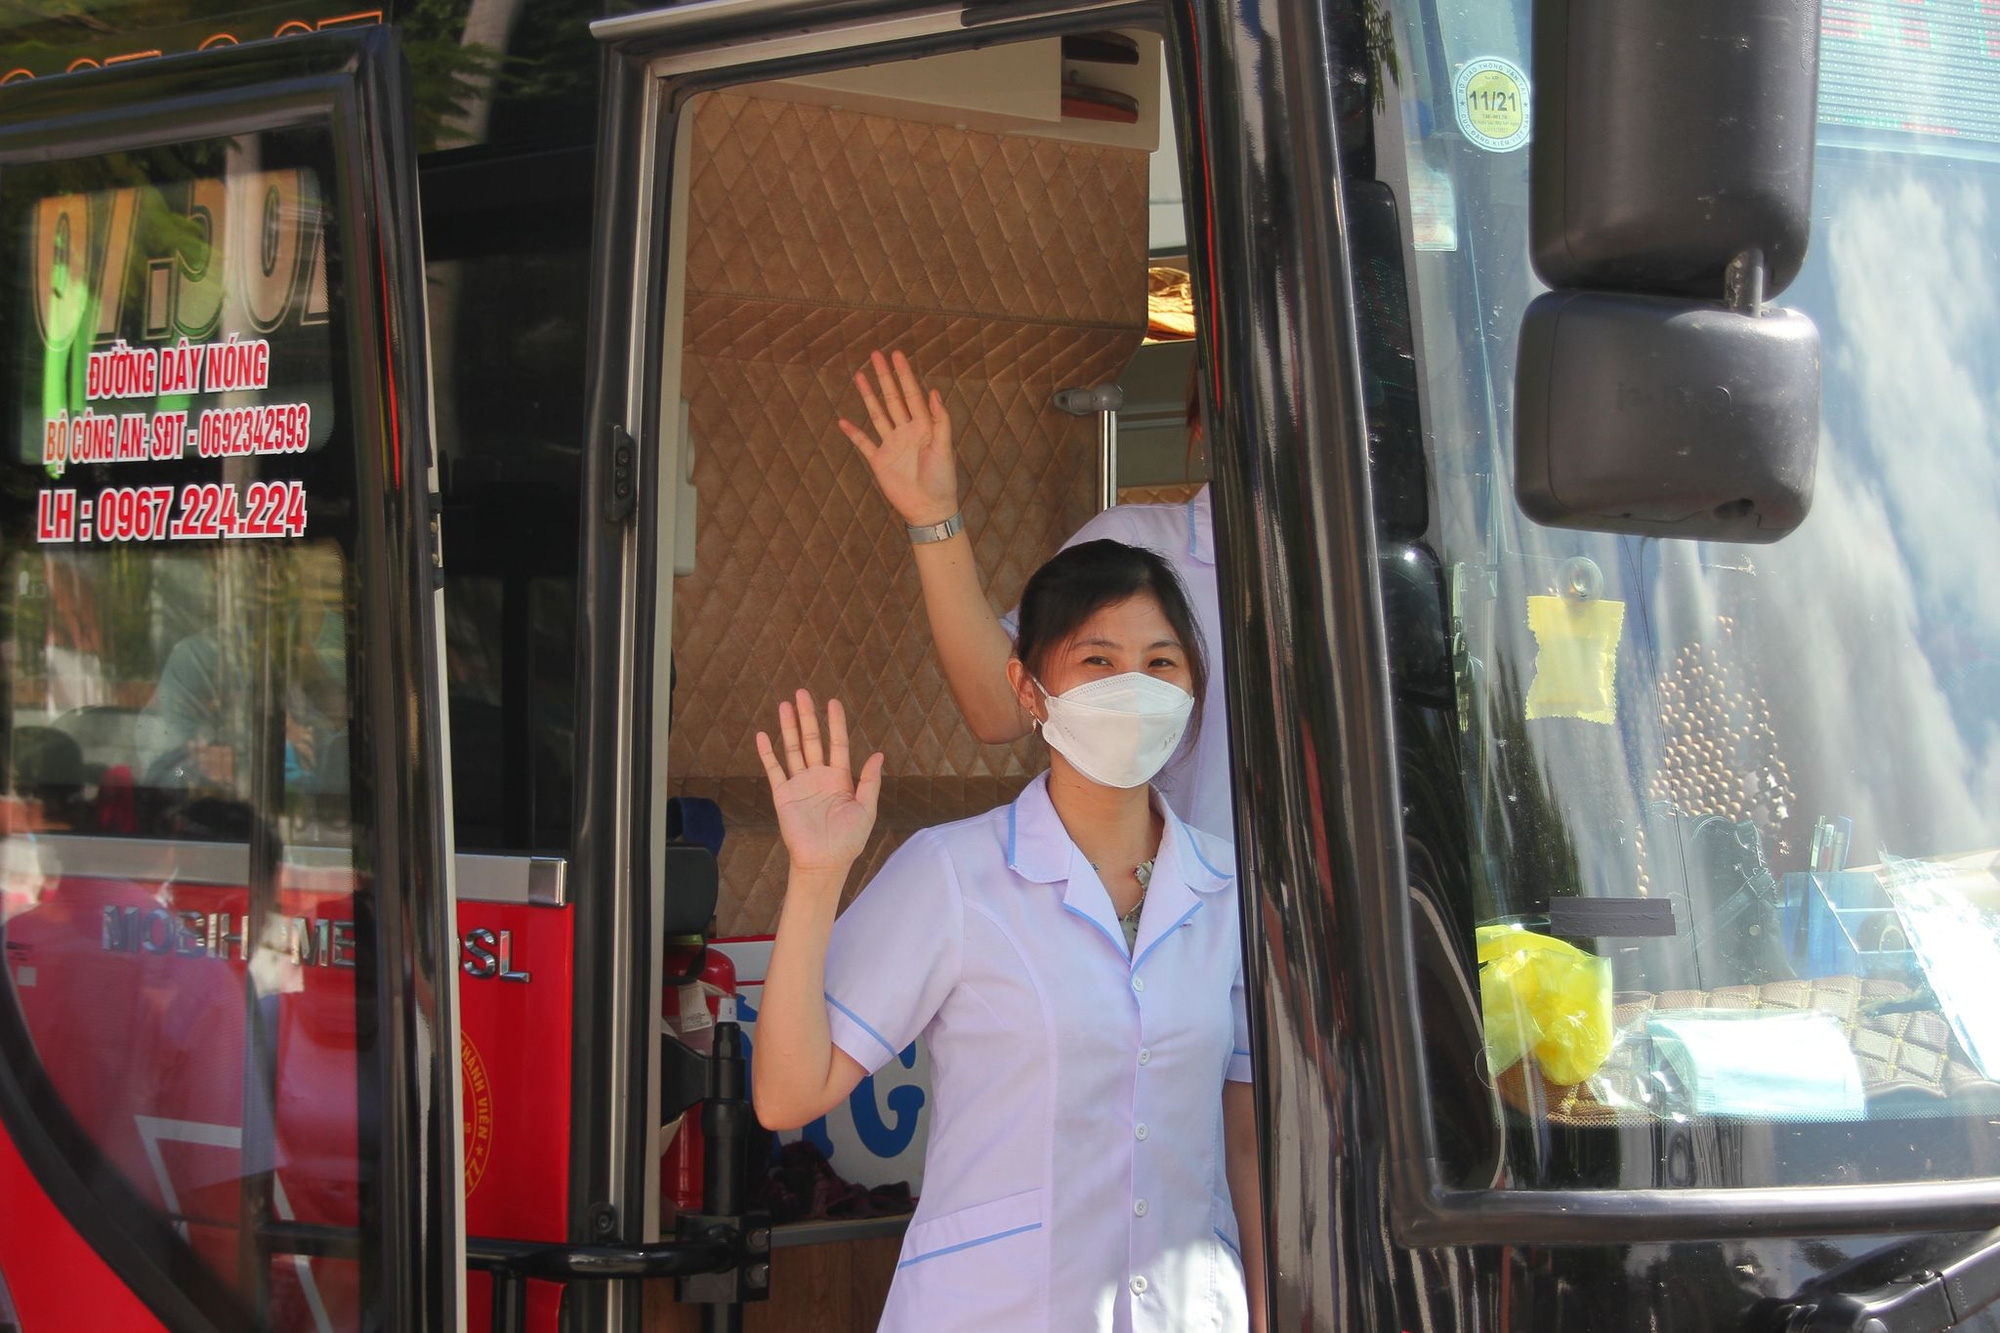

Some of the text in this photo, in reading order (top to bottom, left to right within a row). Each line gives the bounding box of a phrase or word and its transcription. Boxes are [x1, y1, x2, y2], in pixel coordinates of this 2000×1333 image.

[1469, 90, 1516, 112] 11/21
[87, 332, 270, 400] ĐƯỜNG DÂY NÓNG
[43, 408, 68, 474] BỘ
[69, 407, 118, 464] CÔNG
[199, 403, 311, 459] 0692342593
[97, 480, 307, 542] 0967.224.224
